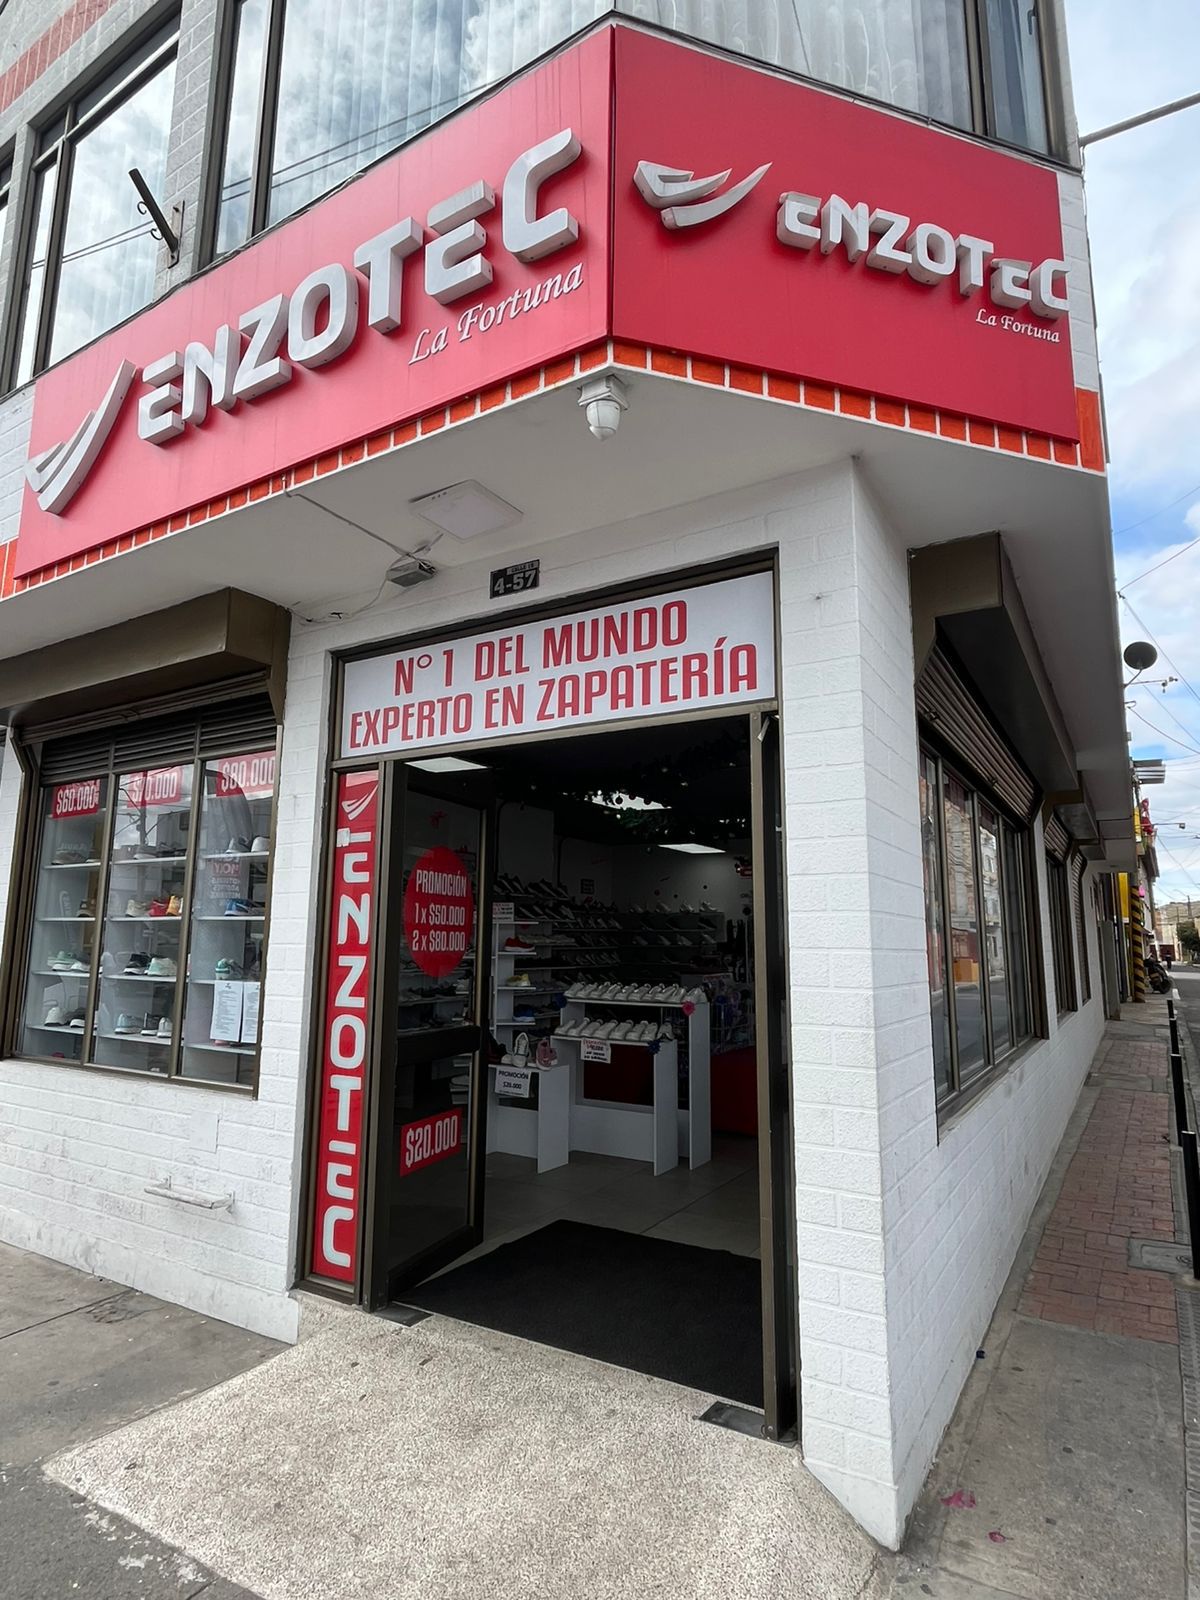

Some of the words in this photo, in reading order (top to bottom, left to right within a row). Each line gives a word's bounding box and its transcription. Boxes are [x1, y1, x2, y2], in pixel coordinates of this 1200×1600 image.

[777, 191, 1070, 319] ENZOTEC
[138, 128, 582, 448] ENZOTEC
[408, 325, 449, 366] La
[457, 262, 584, 343] Fortuna
[975, 308, 998, 327] La
[1001, 314, 1061, 343] Fortuna
[493, 570, 537, 595] 4-57
[442, 648, 455, 688] 1
[474, 633, 531, 682] DEL
[542, 600, 688, 669] MUNDO
[349, 692, 474, 750] EXPERTO
[484, 683, 525, 729] EN
[536, 636, 758, 722] ZAPATERÍA
[221, 756, 275, 792] $80.000
[56, 785, 97, 816] $60.000
[415, 869, 467, 898] PROMOCIÓN
[414, 902, 420, 925] 1
[420, 907, 428, 925] x
[428, 902, 466, 926] $50.000
[412, 929, 420, 952] 2
[420, 934, 428, 952] x
[428, 928, 466, 953] $80.000
[322, 830, 372, 1269] ENZOTEC
[405, 1114, 458, 1169] $20.000
